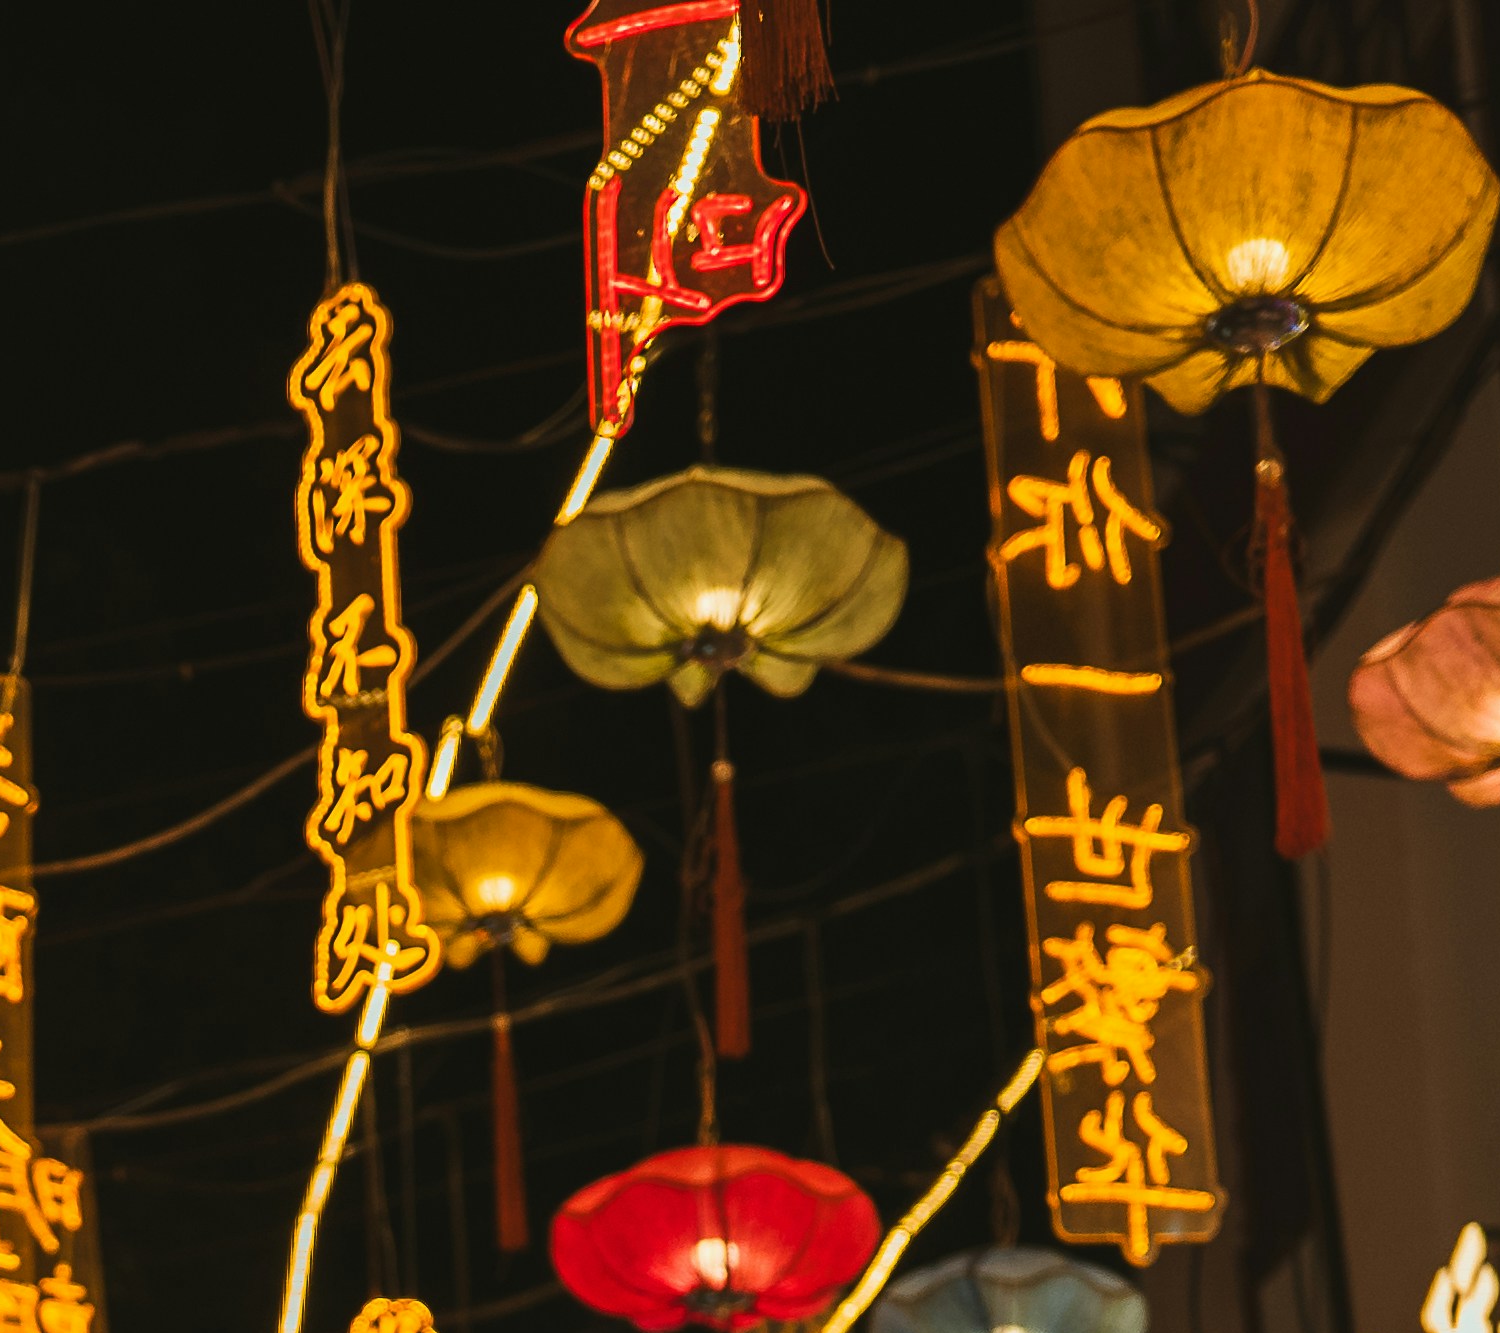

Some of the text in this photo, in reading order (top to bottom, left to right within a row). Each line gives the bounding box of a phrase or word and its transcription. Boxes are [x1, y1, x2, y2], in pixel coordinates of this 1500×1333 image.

[305, 304, 427, 991] 云深不知处
